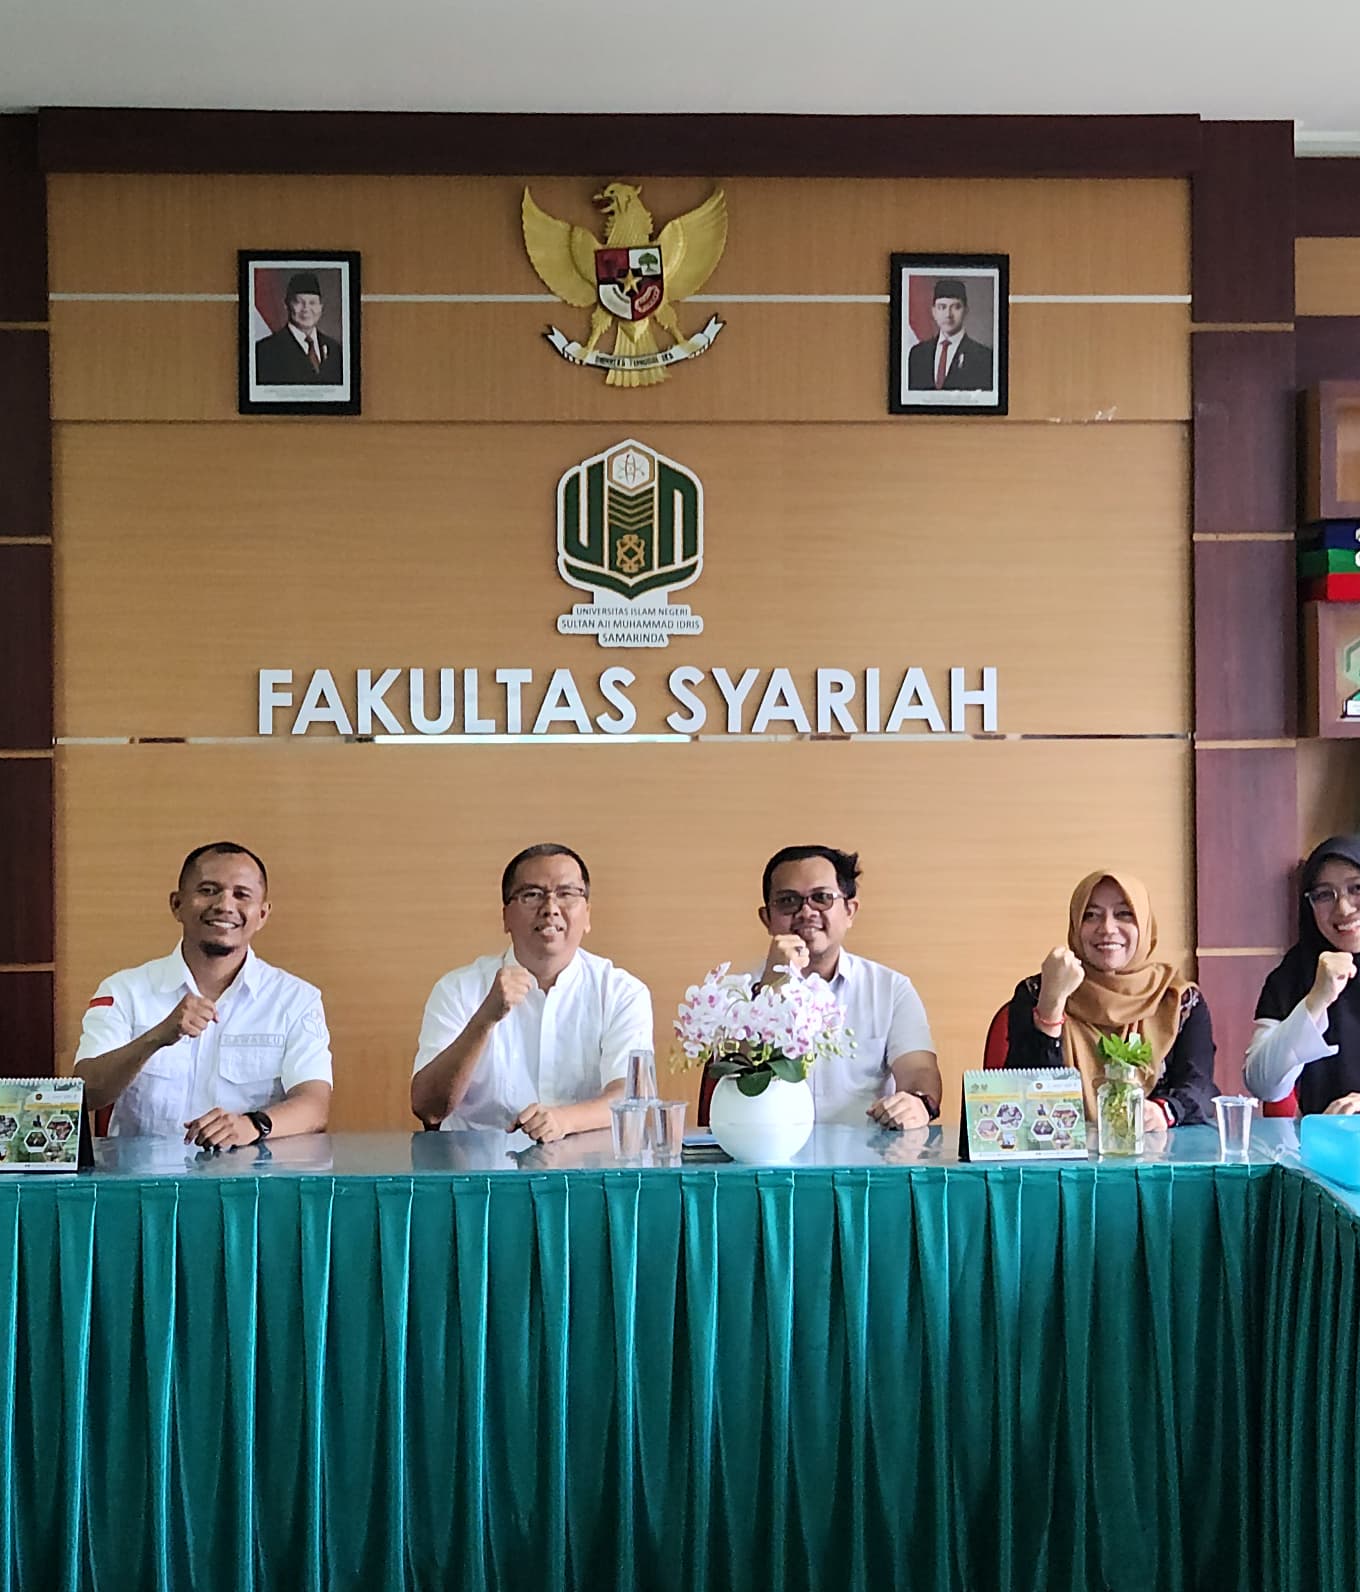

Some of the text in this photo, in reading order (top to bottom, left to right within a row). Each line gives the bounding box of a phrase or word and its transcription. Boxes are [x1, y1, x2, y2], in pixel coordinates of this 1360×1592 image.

[576, 607, 688, 616] UNIVERSITAS ISLAM NEGERI
[561, 619, 700, 630] SULTAN AJI MUHAMMAD IDRIS
[602, 632, 665, 643] SAMARINDA
[258, 665, 997, 735] FAKULTAS SYARIAH
